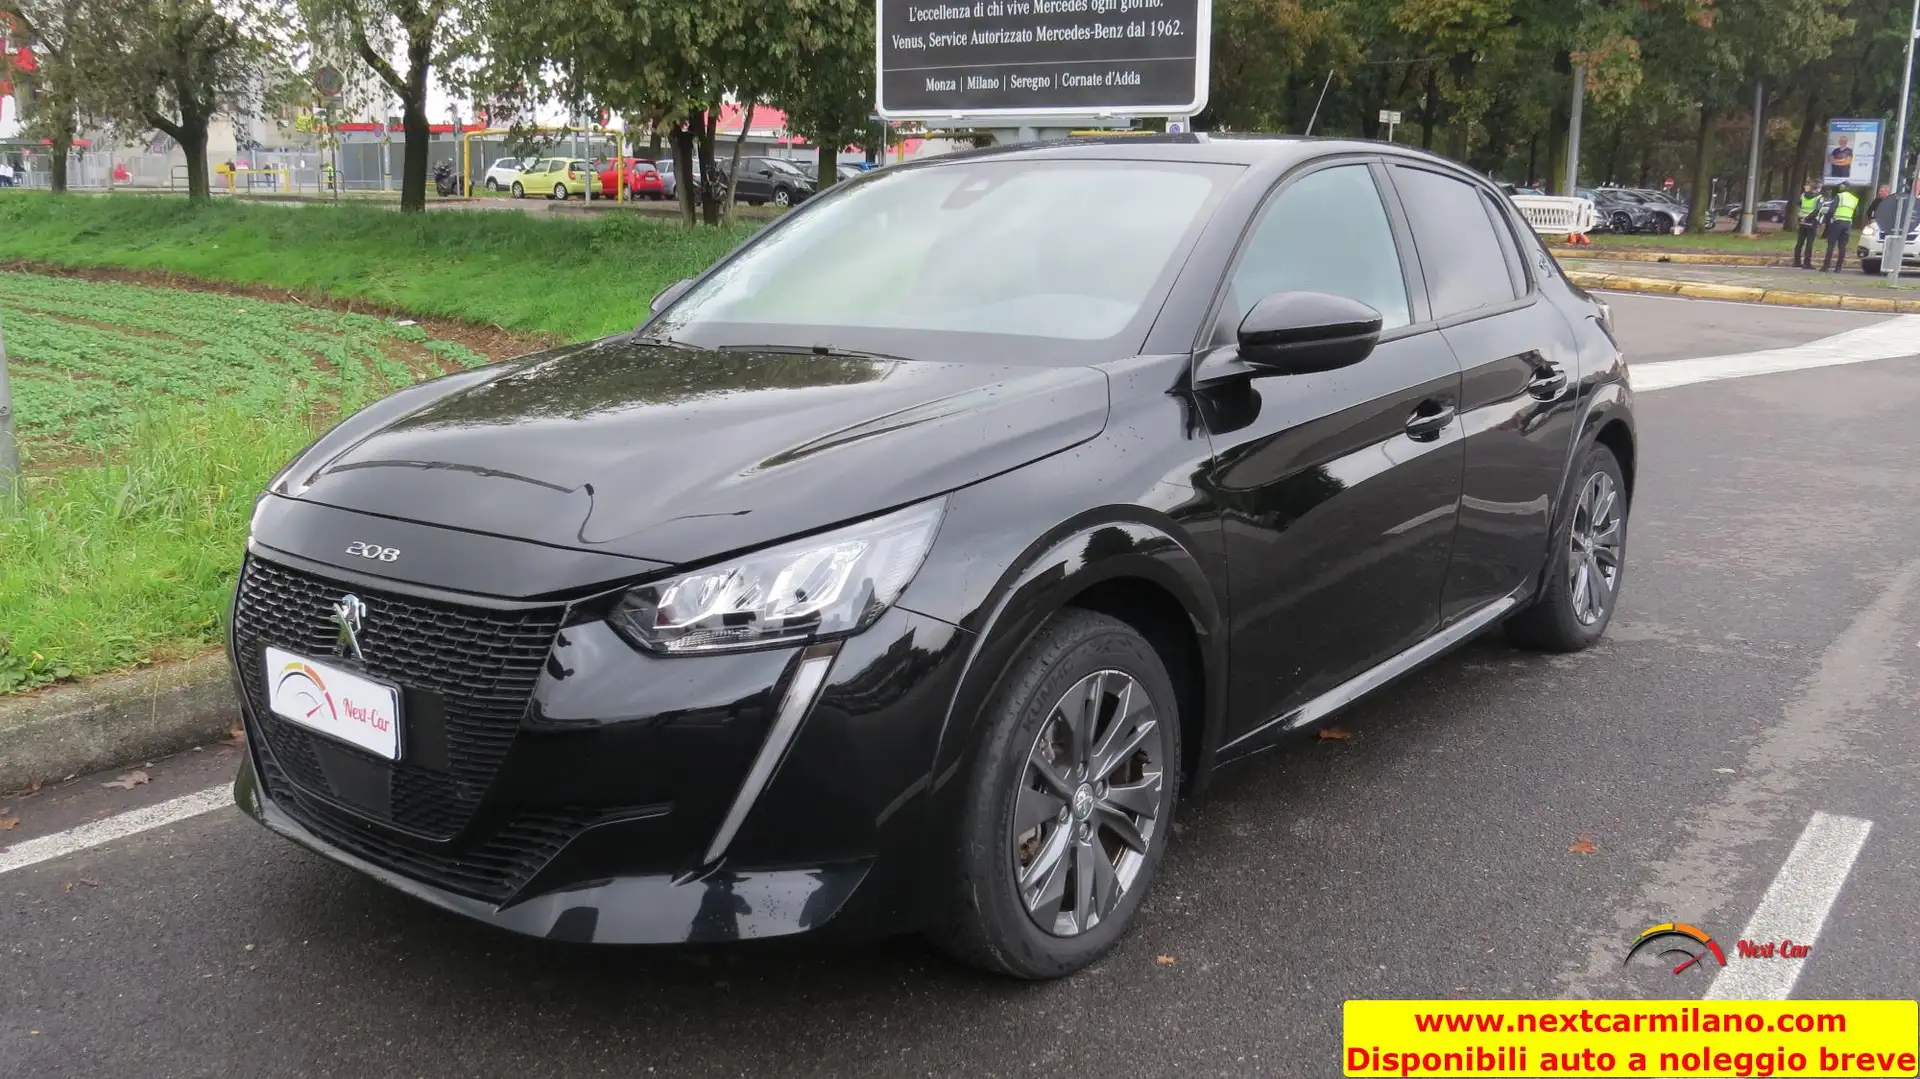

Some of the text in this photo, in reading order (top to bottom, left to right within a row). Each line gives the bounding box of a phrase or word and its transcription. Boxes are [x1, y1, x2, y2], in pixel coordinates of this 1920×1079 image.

[909, 0, 1164, 22] L'eccellenza di chi vive Mercedes ogni giorno.
[892, 18, 1184, 50] Venus, Service Autorizzato Mercedes-Benz dal 1962.
[925, 71, 1141, 92] Monza Milano Seregno Cornate d'Adda
[345, 540, 401, 563] 208
[343, 697, 390, 733] Next-Car
